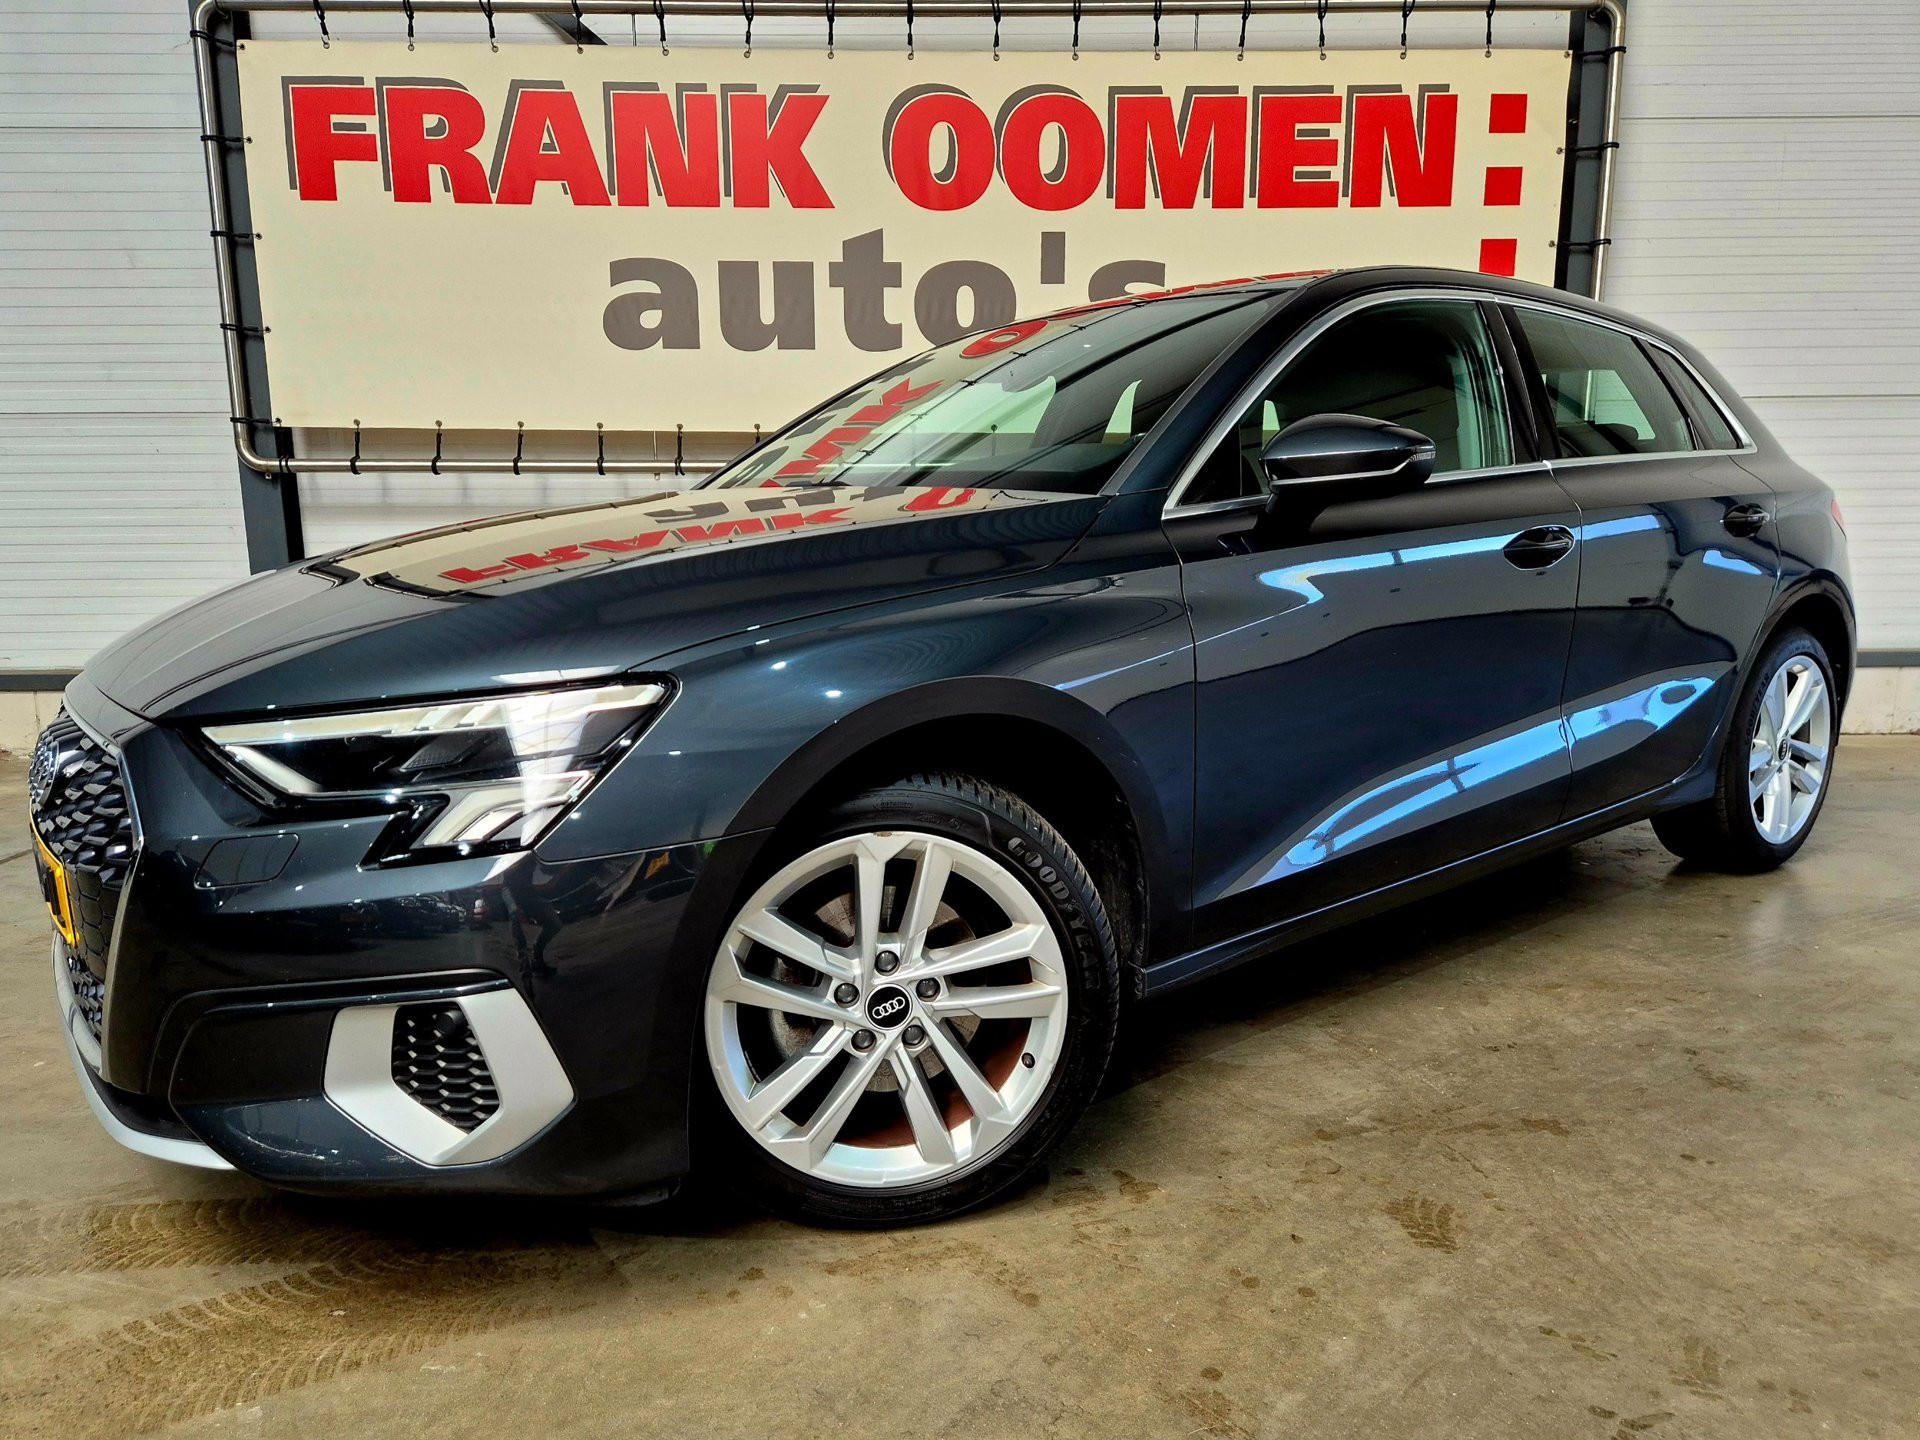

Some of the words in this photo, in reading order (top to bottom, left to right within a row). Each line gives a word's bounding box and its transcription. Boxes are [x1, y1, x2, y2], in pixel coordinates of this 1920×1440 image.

[282, 77, 834, 208] FRANK
[883, 83, 1458, 211] OOMEN
[1007, 836, 1101, 990] GOODYEAR
